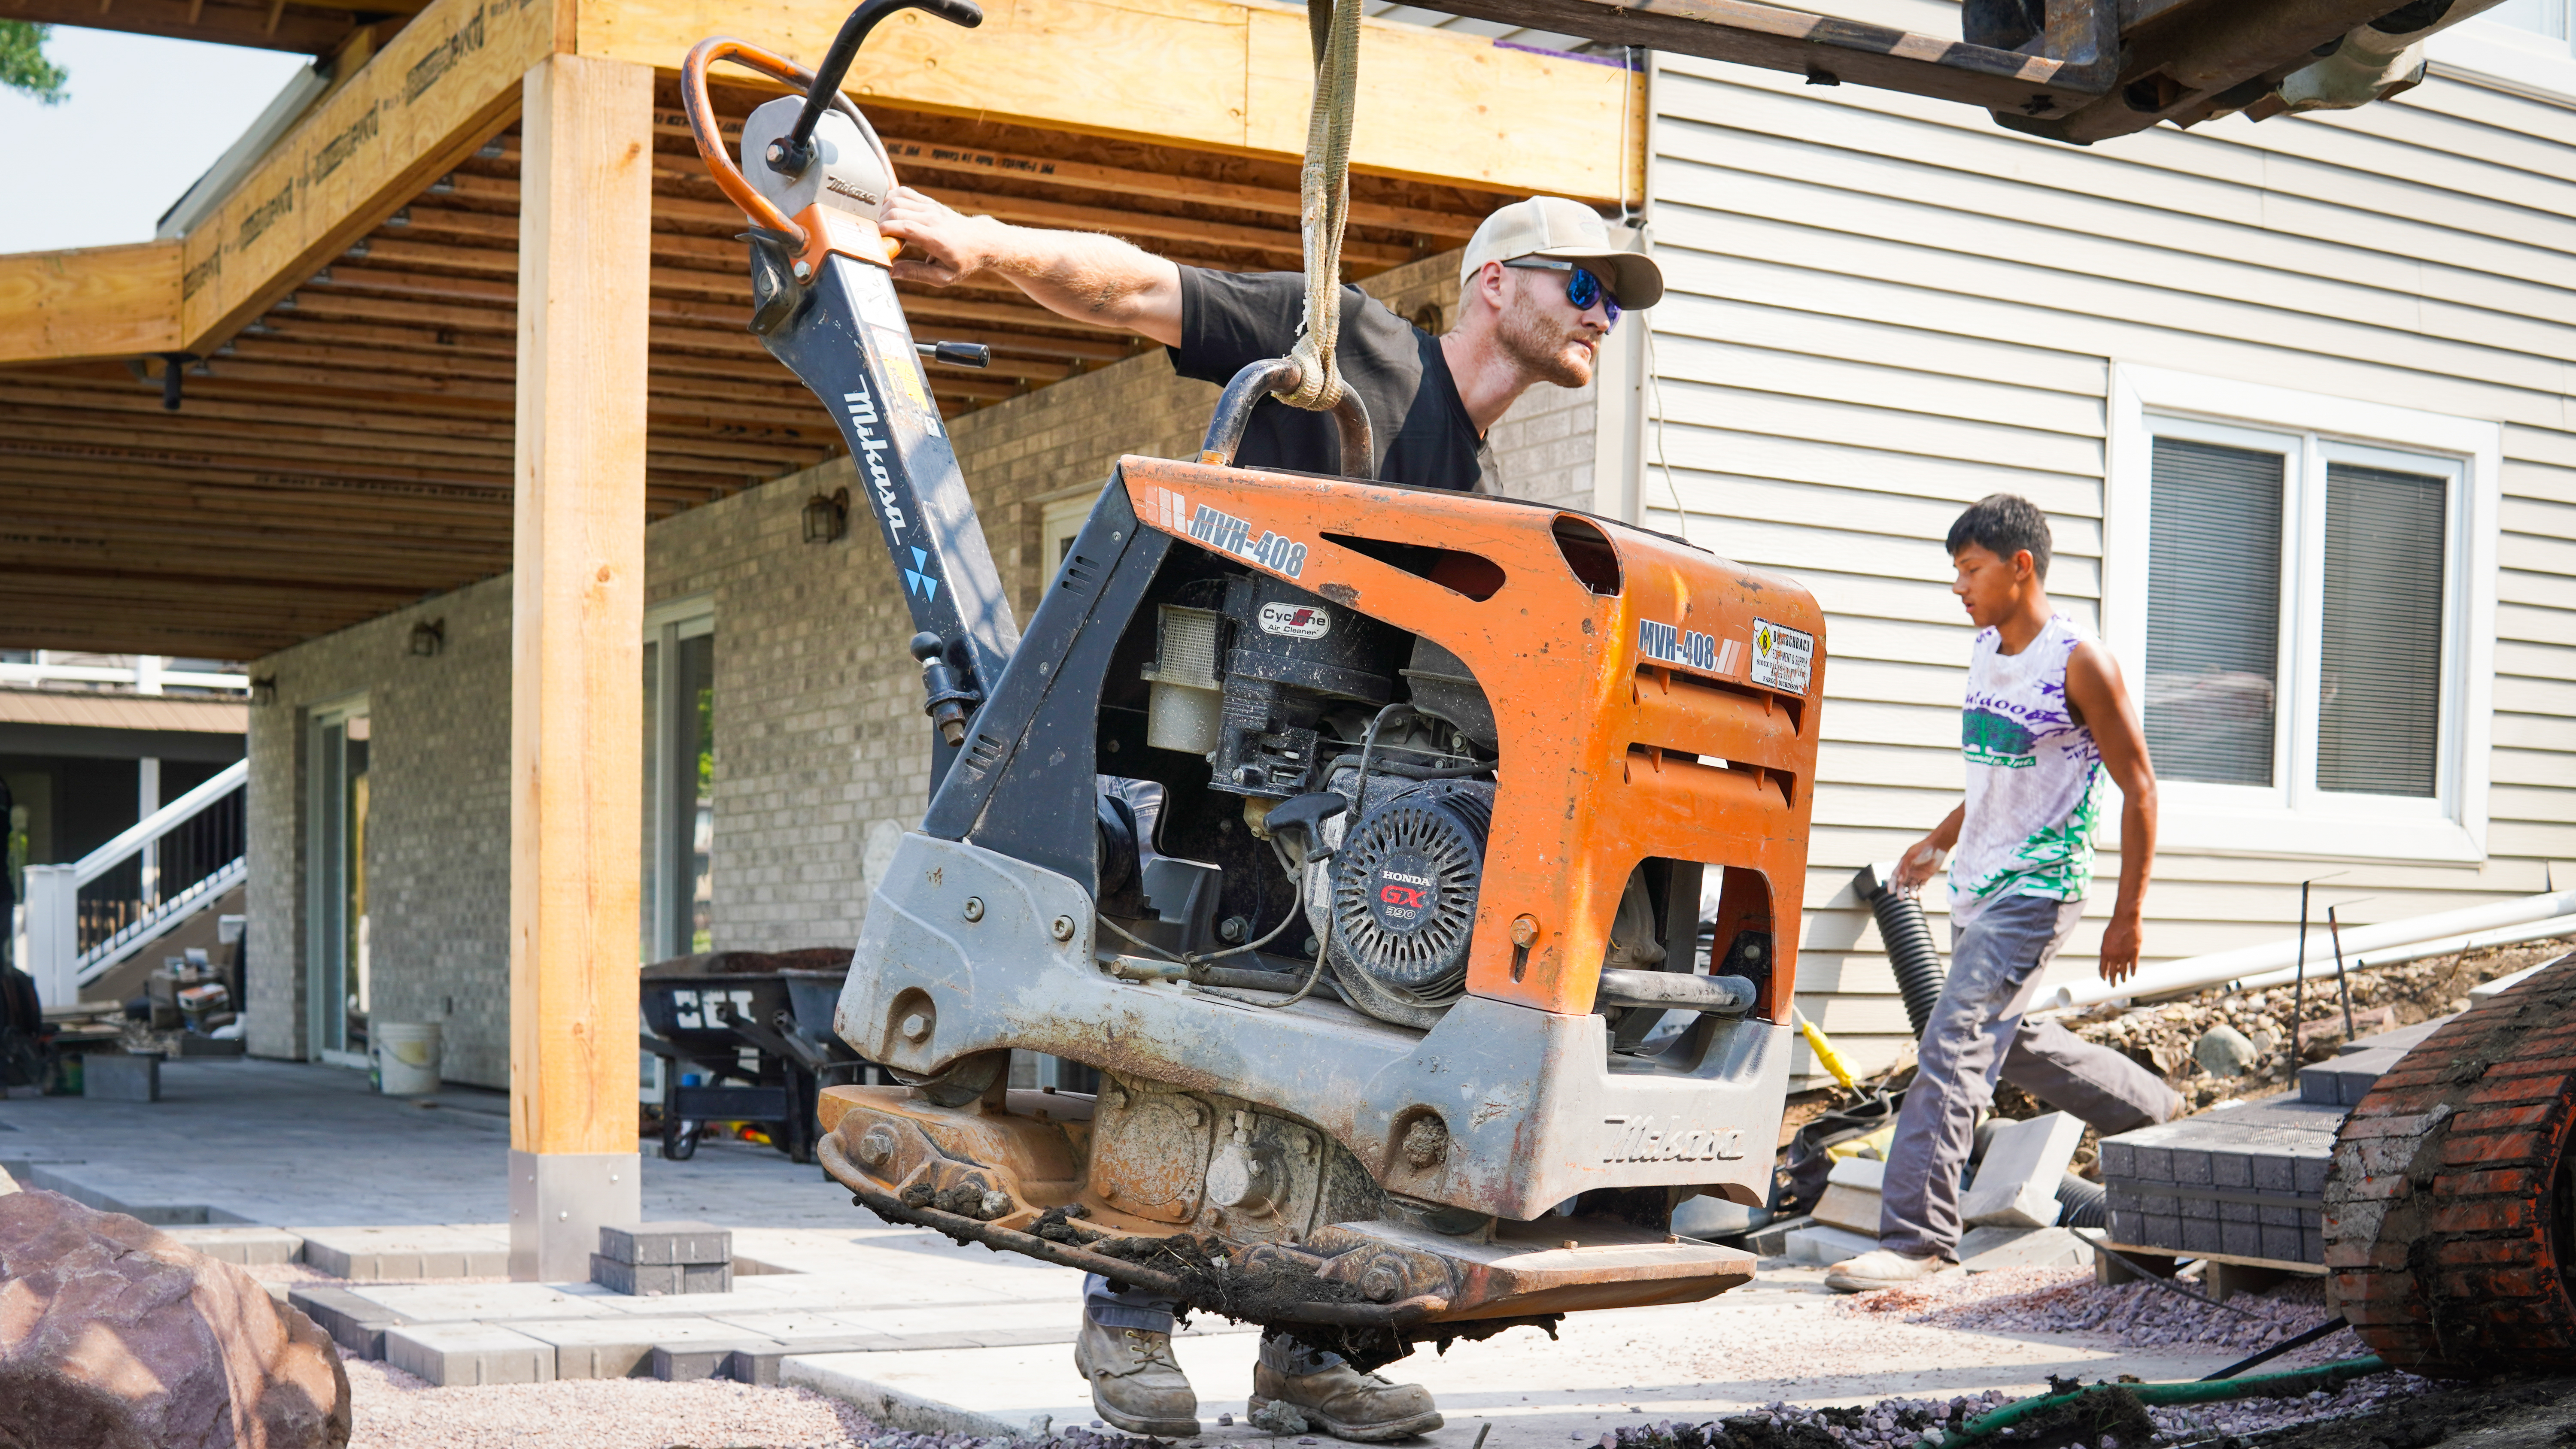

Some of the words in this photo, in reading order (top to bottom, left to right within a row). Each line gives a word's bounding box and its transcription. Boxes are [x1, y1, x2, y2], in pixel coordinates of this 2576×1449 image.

[826, 174, 877, 205] Mikasa
[844, 375, 906, 546] Mikasa
[1189, 504, 1305, 578] MVH-408
[1264, 609, 1325, 626] Cyclone
[1284, 626, 1316, 636] Cleaner
[1639, 620, 1715, 670] MVH-408
[1763, 635, 1768, 649] B
[1757, 659, 1769, 668] SIOUX
[1772, 649, 1791, 664] EQPMENT
[1792, 655, 1794, 664] &
[1763, 676, 1776, 685] FARGO
[1779, 680, 1799, 691] DICKINSON
[1382, 870, 1431, 886] HONDA
[1381, 885, 1427, 908] GX
[1385, 906, 1416, 919] 390
[1603, 1115, 1745, 1163] Mikasa
